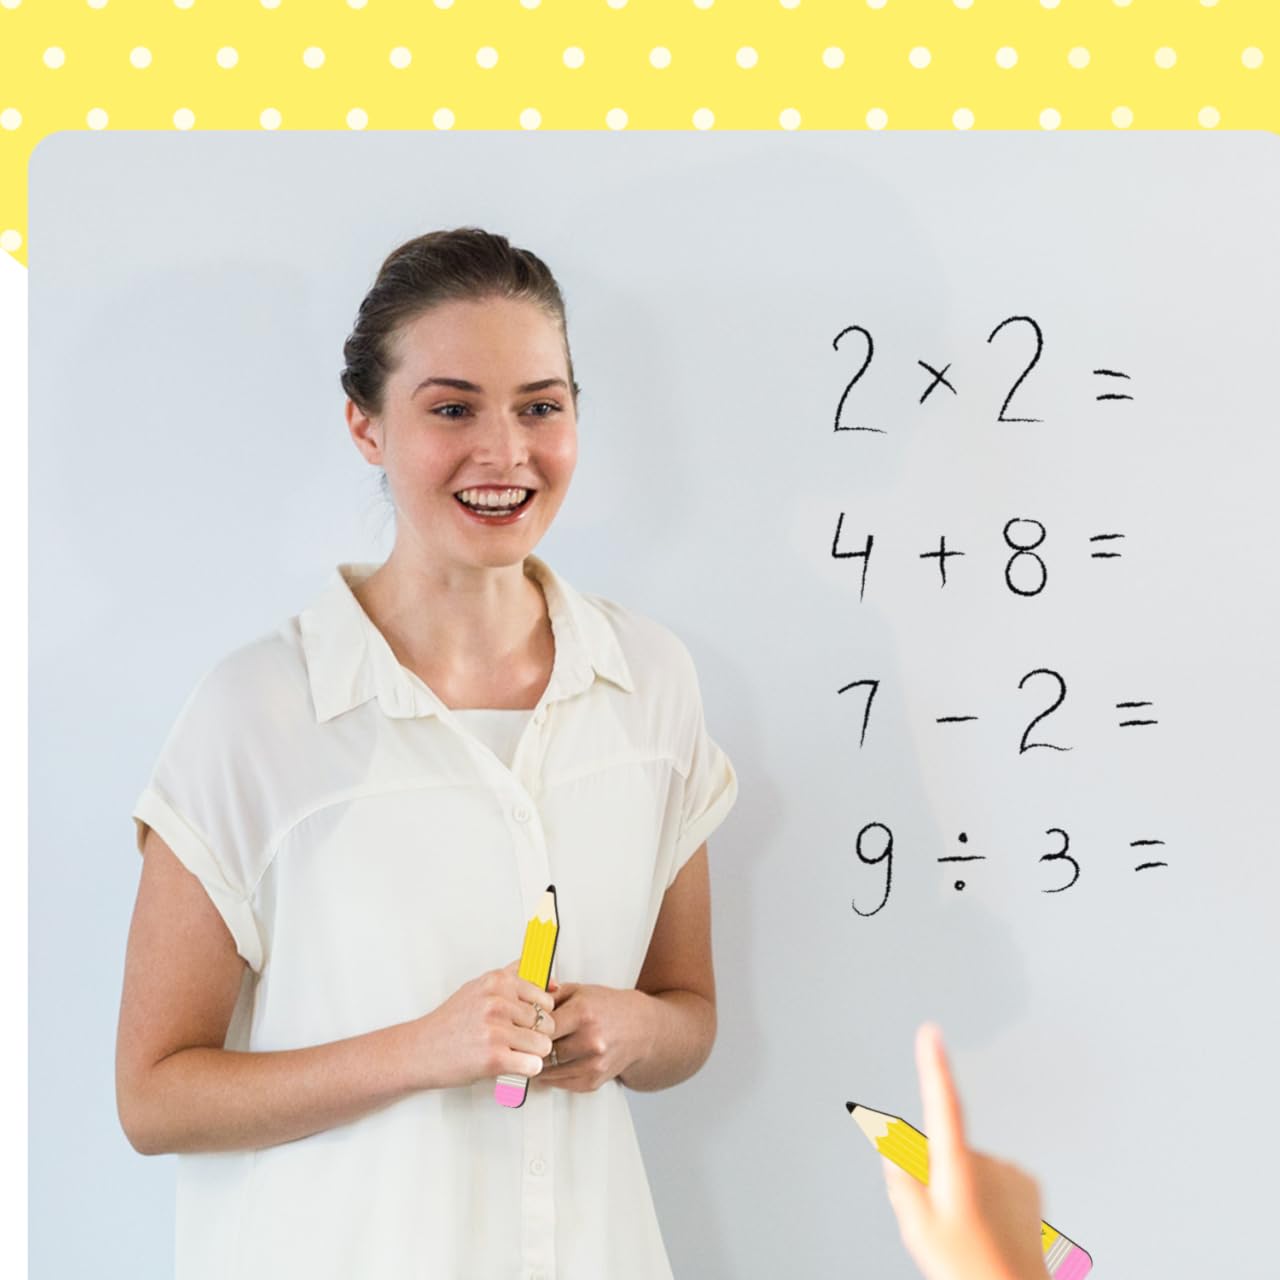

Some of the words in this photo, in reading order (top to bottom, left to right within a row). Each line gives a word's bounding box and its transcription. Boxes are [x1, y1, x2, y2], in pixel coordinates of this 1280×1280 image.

[831, 324, 888, 434] 2
[986, 314, 1045, 423] 2
[830, 511, 875, 602] 4
[1001, 516, 1049, 598] 8
[836, 678, 881, 749] 7
[1017, 667, 1073, 756] 2
[851, 820, 895, 918] 9
[1038, 827, 1081, 894] 3
